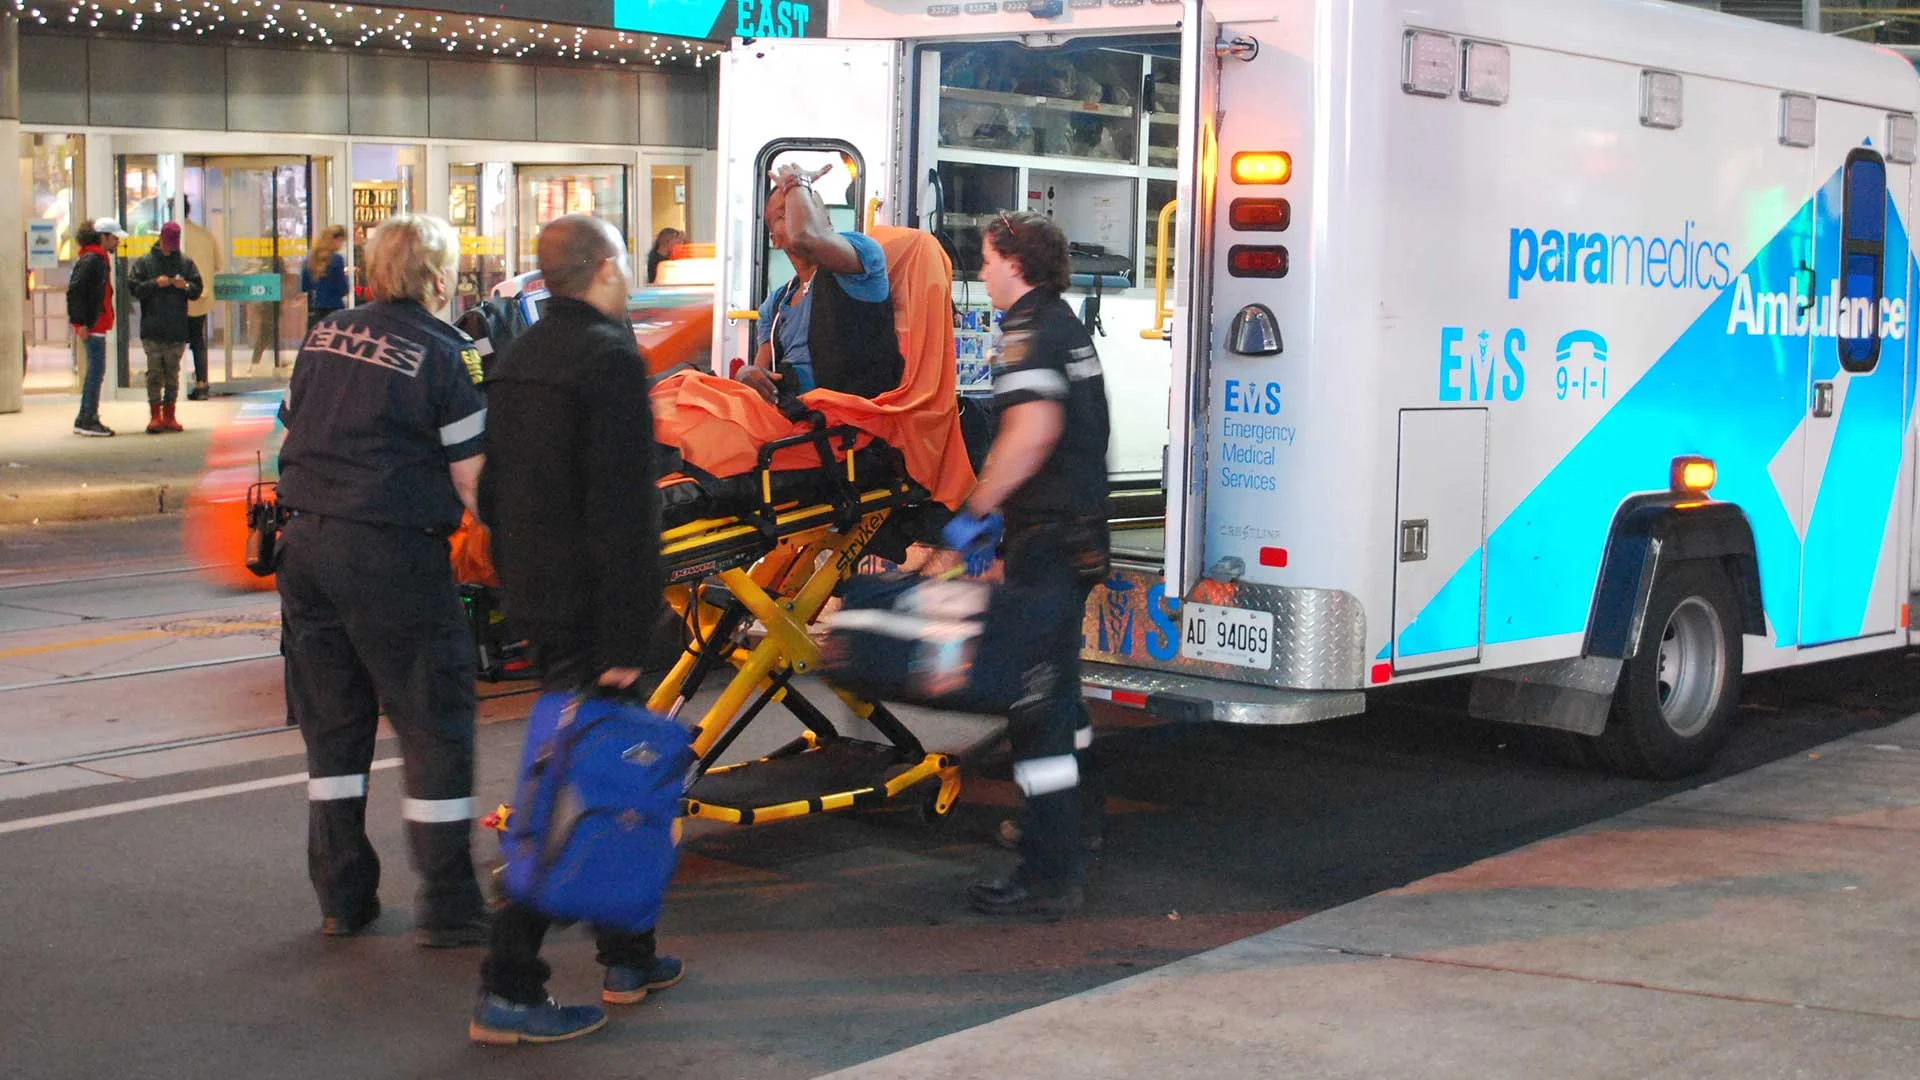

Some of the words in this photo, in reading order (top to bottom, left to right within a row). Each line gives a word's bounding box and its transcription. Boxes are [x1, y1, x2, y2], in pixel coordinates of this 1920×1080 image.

[735, 0, 809, 38] EAST
[1508, 220, 1731, 300] paramedics
[1727, 272, 1906, 340] Ambulance
[305, 328, 422, 376] EMS
[1439, 326, 1527, 402] EMS
[1223, 379, 1282, 416] EMS
[1223, 417, 1296, 446] Emergency
[1222, 442, 1275, 465] Medical
[1221, 466, 1276, 491] Services
[1082, 573, 1182, 662] MS
[1186, 618, 1206, 645] AD
[1216, 621, 1268, 654] 94069
